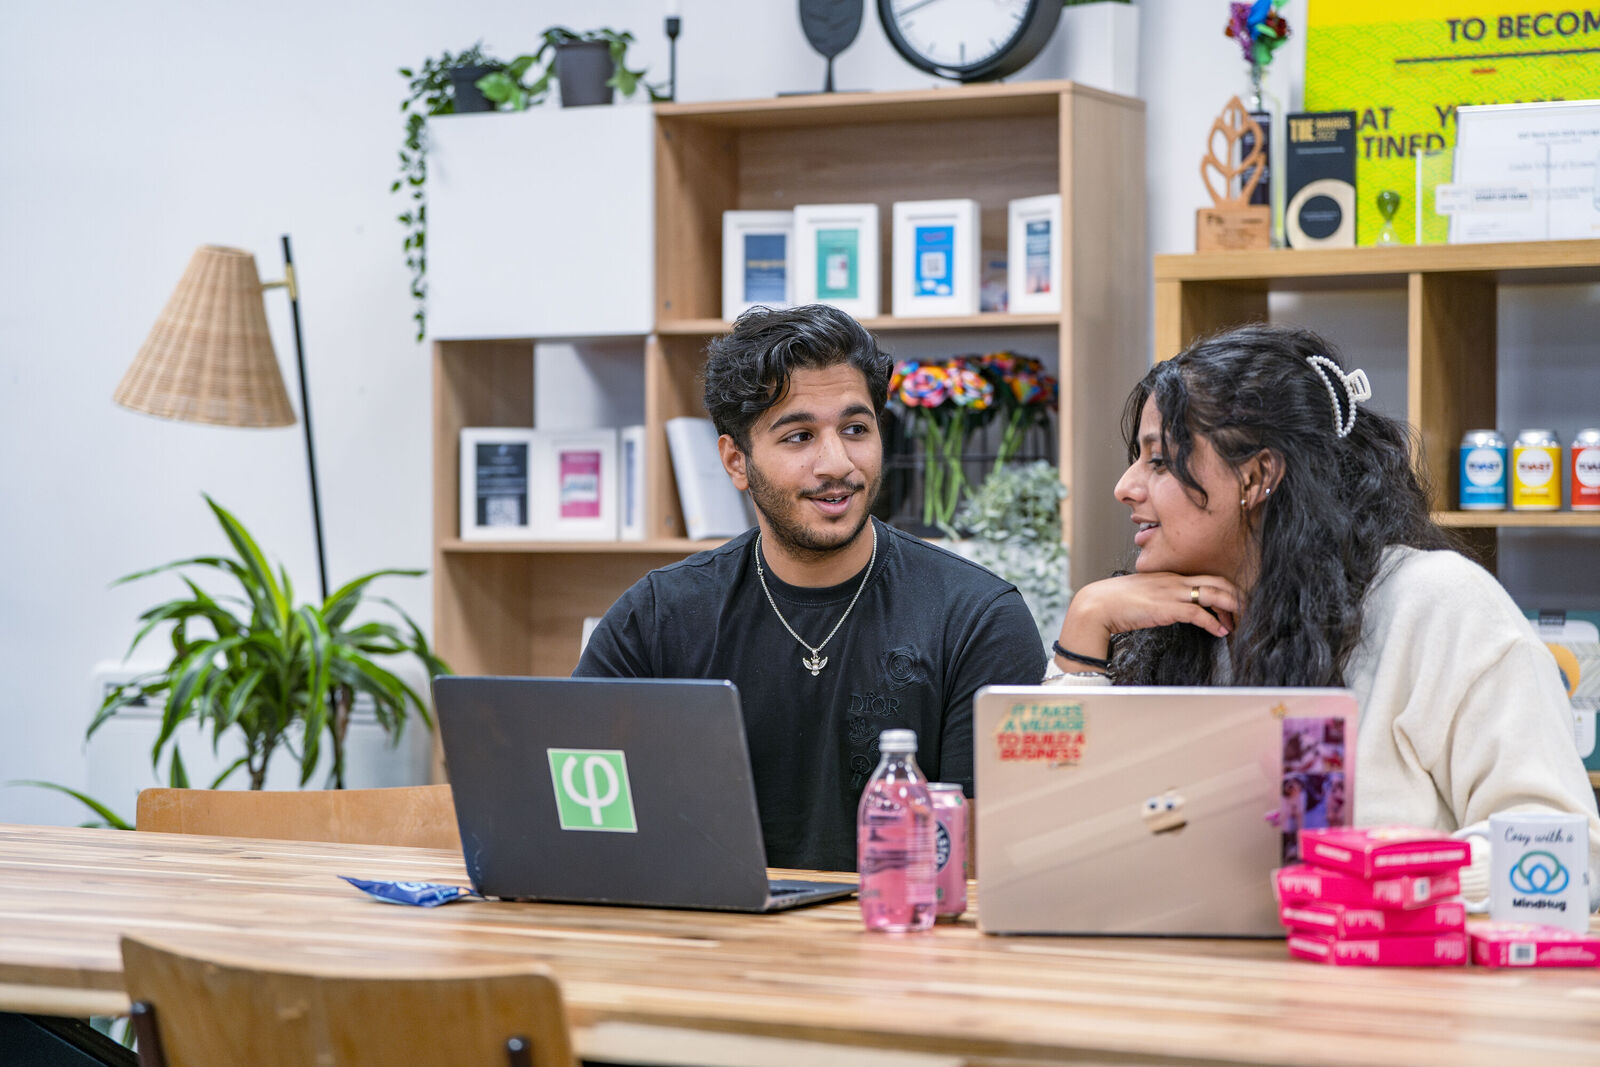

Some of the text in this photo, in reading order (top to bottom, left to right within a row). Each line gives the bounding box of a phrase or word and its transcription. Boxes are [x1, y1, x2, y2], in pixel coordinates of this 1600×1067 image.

[1446, 18, 1486, 43] TO
[1357, 107, 1394, 131] AT
[1362, 133, 1446, 159] TINED
[849, 695, 901, 715] DIOR
[1023, 733, 1072, 748] BUILD
[1000, 748, 1082, 762] BUSINESS
[1512, 898, 1567, 912] MindHug
